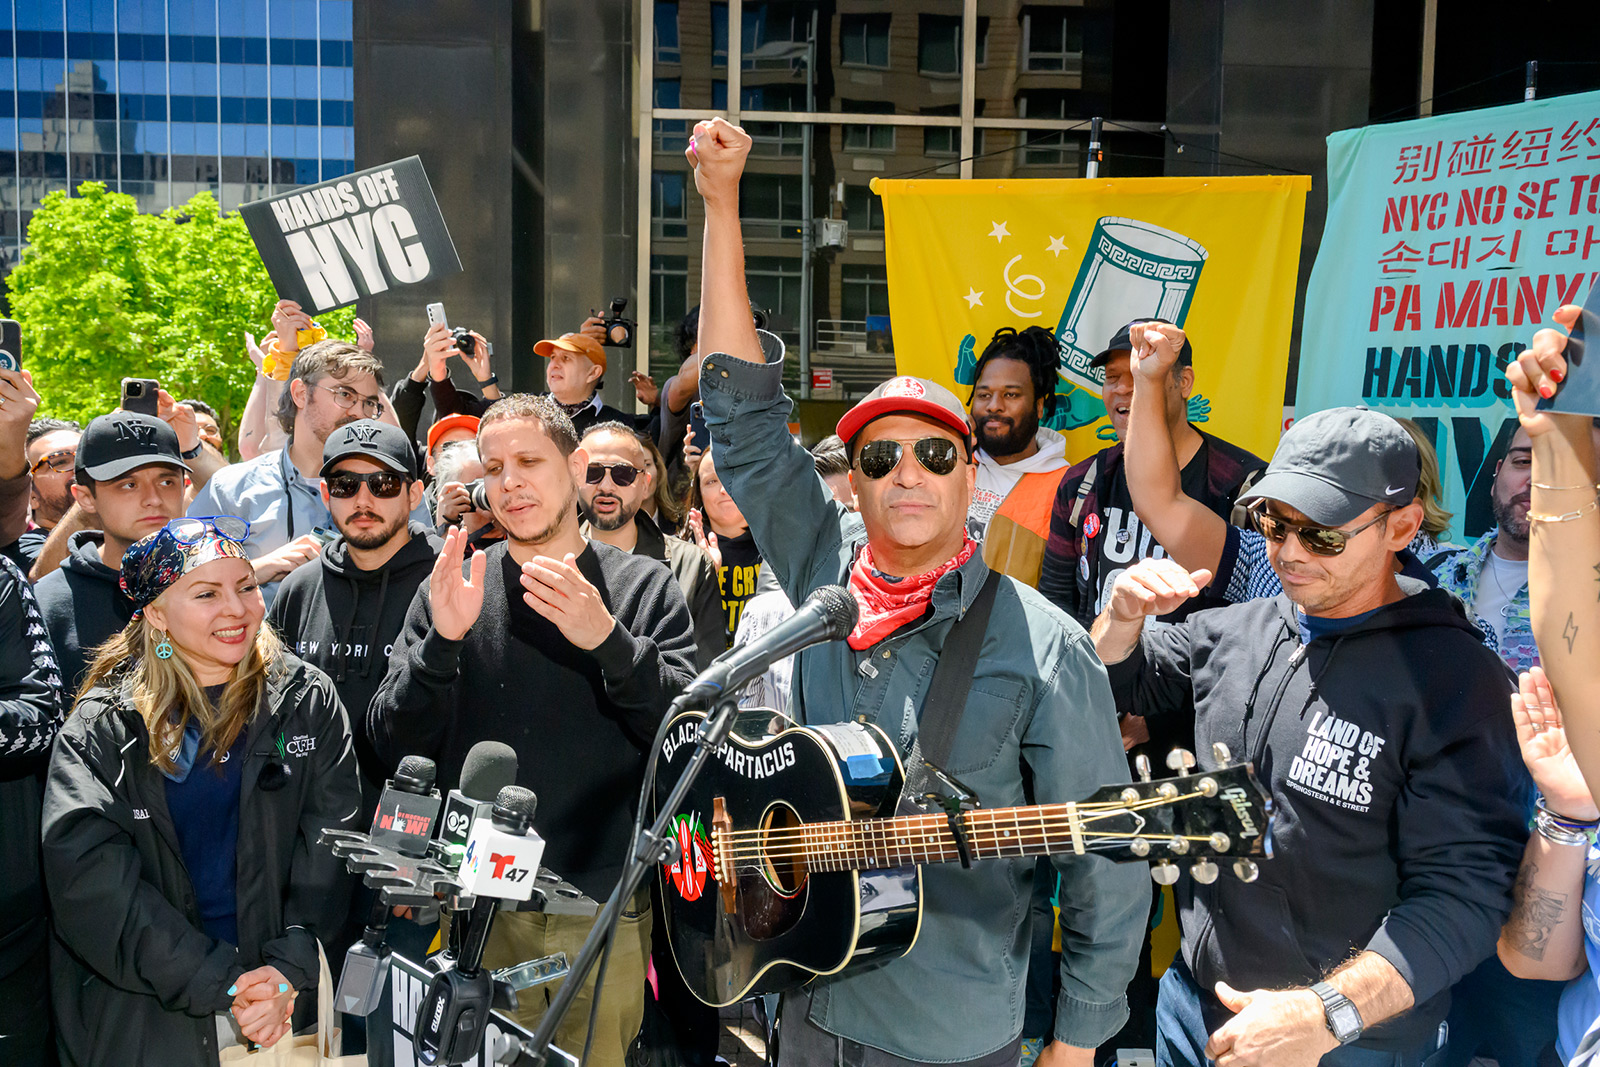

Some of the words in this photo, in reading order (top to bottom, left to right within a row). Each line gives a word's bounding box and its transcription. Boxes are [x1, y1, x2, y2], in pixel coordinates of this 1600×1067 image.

[269, 181, 360, 233] HANDS
[356, 168, 400, 208] OFF
[1382, 191, 1449, 234] NYC
[1455, 185, 1508, 228] NO
[1513, 178, 1560, 220] SE
[284, 203, 431, 312] NYC
[1378, 229, 1522, 274] 손대지
[1369, 284, 1421, 332] PA
[1434, 271, 1600, 329] MANY
[343, 423, 383, 449] NY
[1302, 735, 1354, 775] HOPE
[1354, 756, 1371, 782] &
[1307, 711, 1361, 749] LAND
[1358, 731, 1386, 760] OF
[1286, 779, 1329, 802] SPRINGSTEEN
[1342, 801, 1370, 813] STREET
[1288, 755, 1374, 805] DREAMS
[1219, 786, 1260, 840] Gibson
[505, 868, 529, 883] 47
